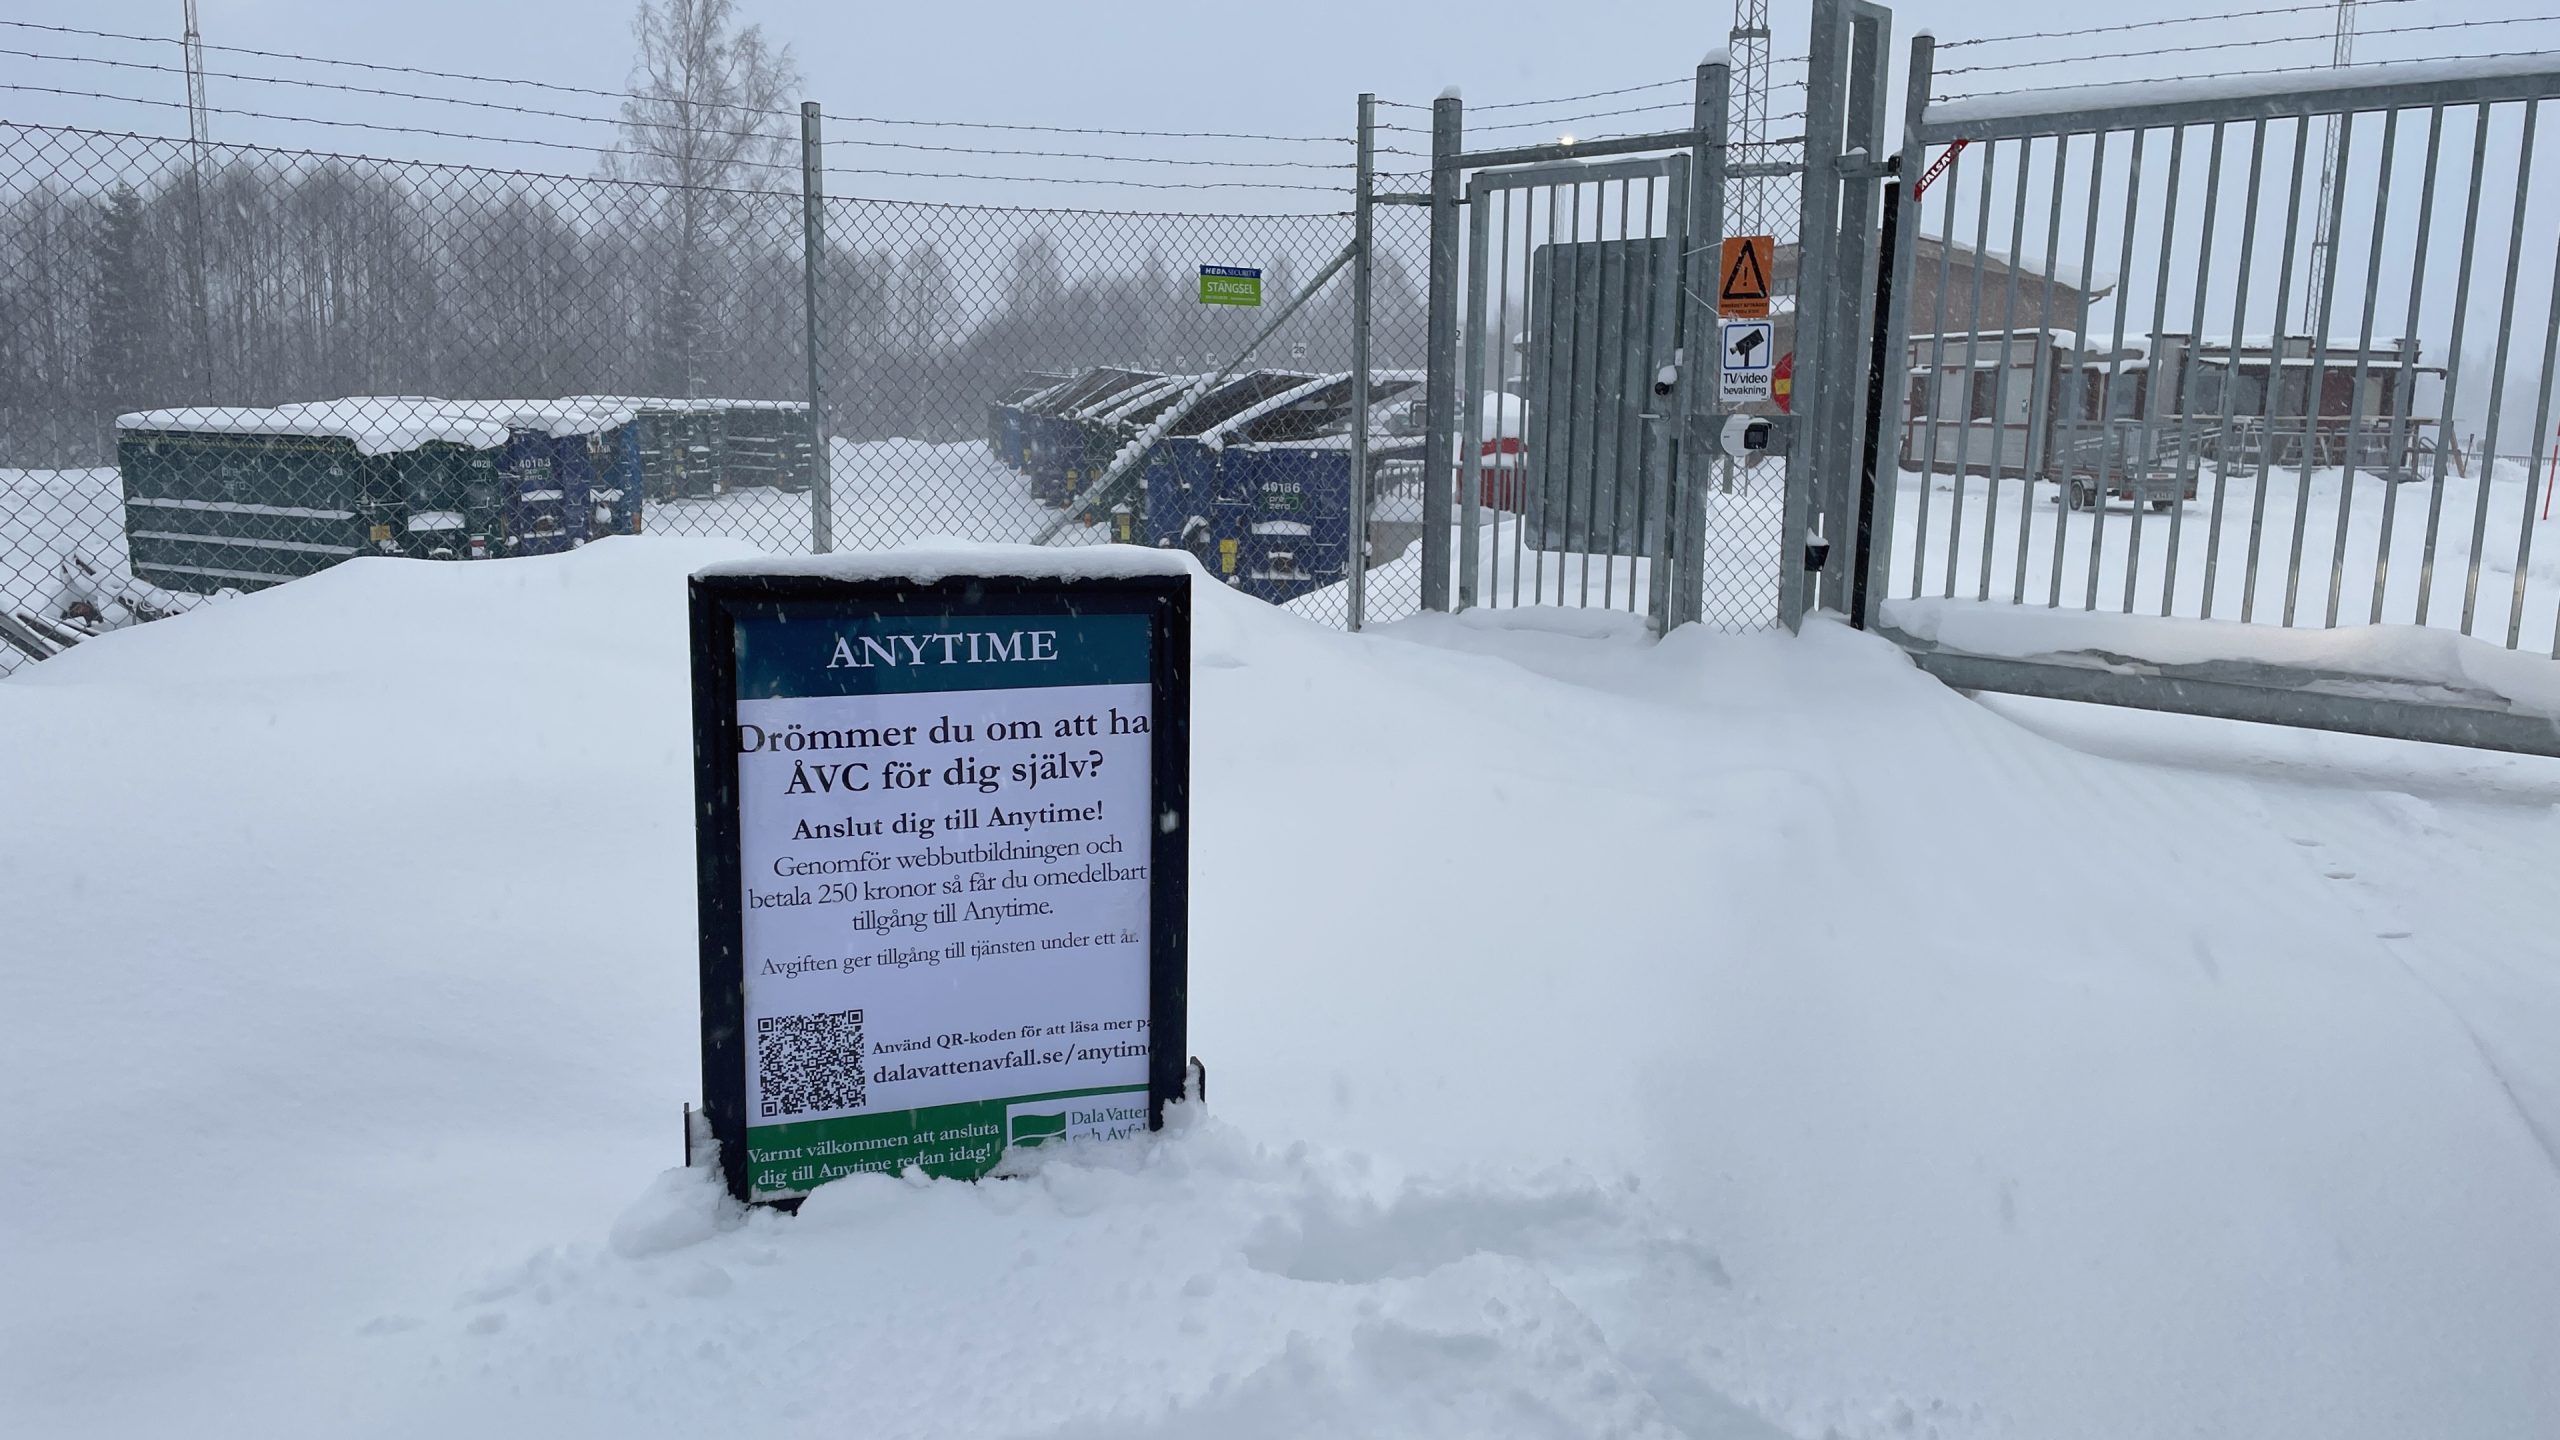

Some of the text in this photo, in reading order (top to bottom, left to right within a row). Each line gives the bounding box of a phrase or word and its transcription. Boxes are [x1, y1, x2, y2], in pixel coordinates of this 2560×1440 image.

[1207, 280, 1255, 295] STÄNGSEL
[1723, 373, 1768, 384] TV/video
[1723, 386, 1767, 396] bevakning
[826, 631, 1058, 668] ANYTIME
[737, 708, 1150, 754] Drömmer du om att ha
[784, 750, 1103, 795] ÅVC för dig själv?
[792, 800, 1102, 840] Anslut dig till Anytime!
[774, 834, 1123, 876] Genomför webbutbildningen och
[749, 862, 1146, 908] betala 250 kronor så får du omedelbart
[852, 898, 1053, 936] tillgång till Anytime.
[761, 931, 1138, 979] Avgiften ger tillgång till tjänsten under ett år.
[872, 1036, 931, 1055] Använd
[937, 1029, 1016, 1049] QR-koden
[1021, 1026, 1042, 1038] för
[1047, 1025, 1065, 1035] att
[1070, 1021, 1099, 1033] läsa
[1104, 1020, 1132, 1030] mer
[1072, 1109, 1104, 1125] Dala
[747, 1123, 999, 1163] Varmt välkommen att ansluta
[758, 1143, 990, 1188] dig till Anytime redan idag!
